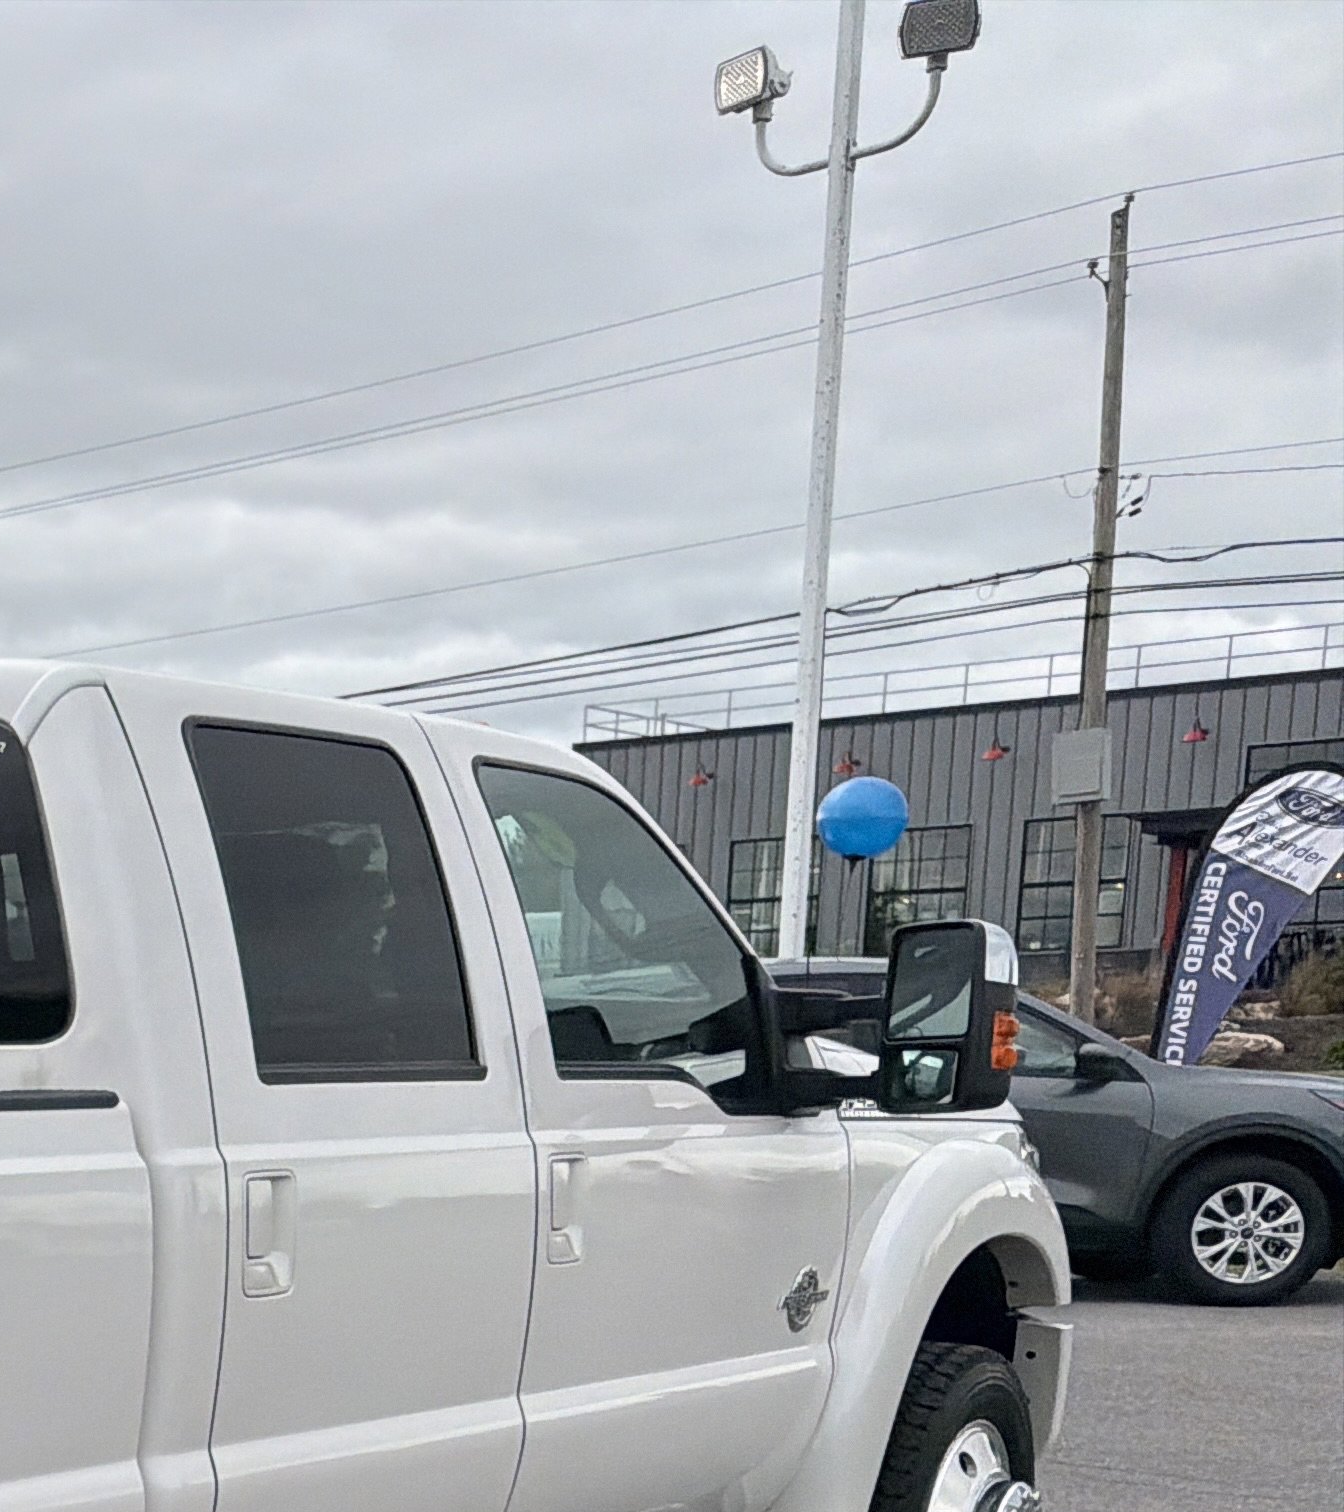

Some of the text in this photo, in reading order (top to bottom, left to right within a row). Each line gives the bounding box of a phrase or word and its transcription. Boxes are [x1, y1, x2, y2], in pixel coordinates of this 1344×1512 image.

[1288, 793, 1341, 822] Ford
[1224, 821, 1329, 866] Alexander
[1182, 862, 1227, 974] CERTIFIED
[1211, 890, 1265, 983] Ford
